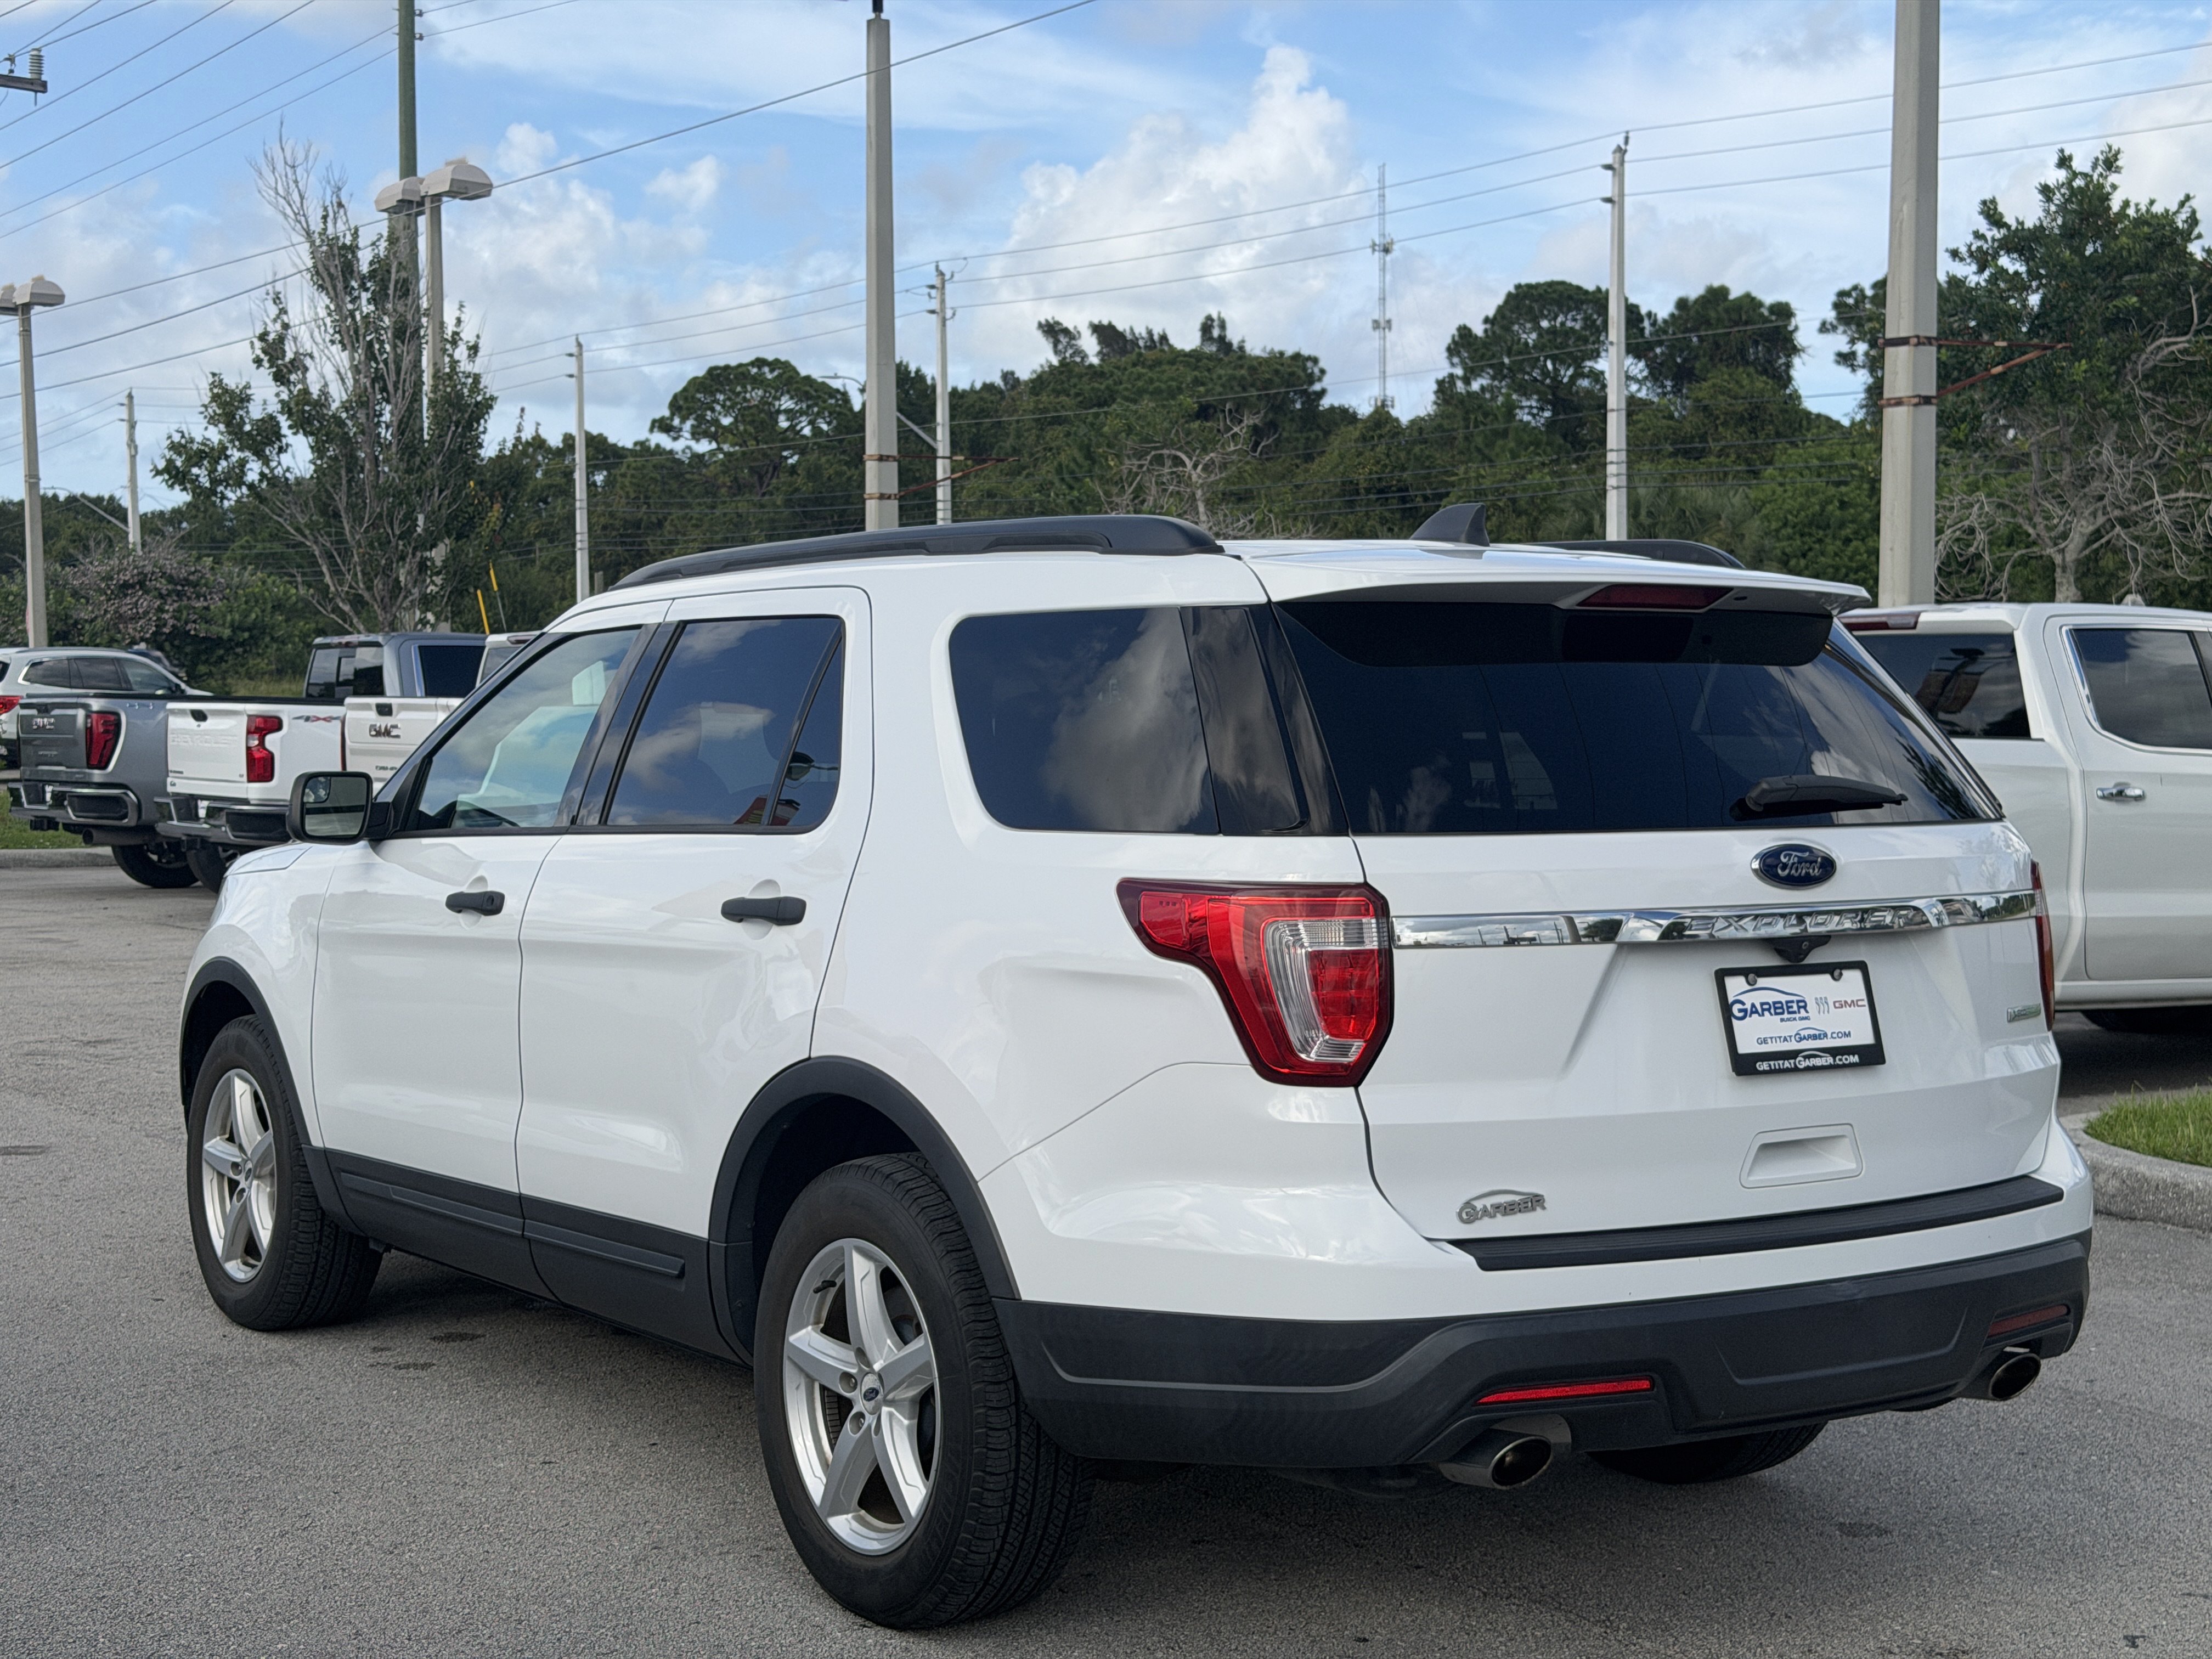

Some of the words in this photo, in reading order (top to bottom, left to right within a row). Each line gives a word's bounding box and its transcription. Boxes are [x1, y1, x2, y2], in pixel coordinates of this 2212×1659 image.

[369, 723, 400, 738] GMC
[1777, 851, 1822, 877] Ford
[1685, 909, 1914, 932] EXPLORER
[1730, 999, 1809, 1021] GARBER
[1833, 998, 1866, 1009] GMC
[1457, 1195, 1547, 1223] GARBER
